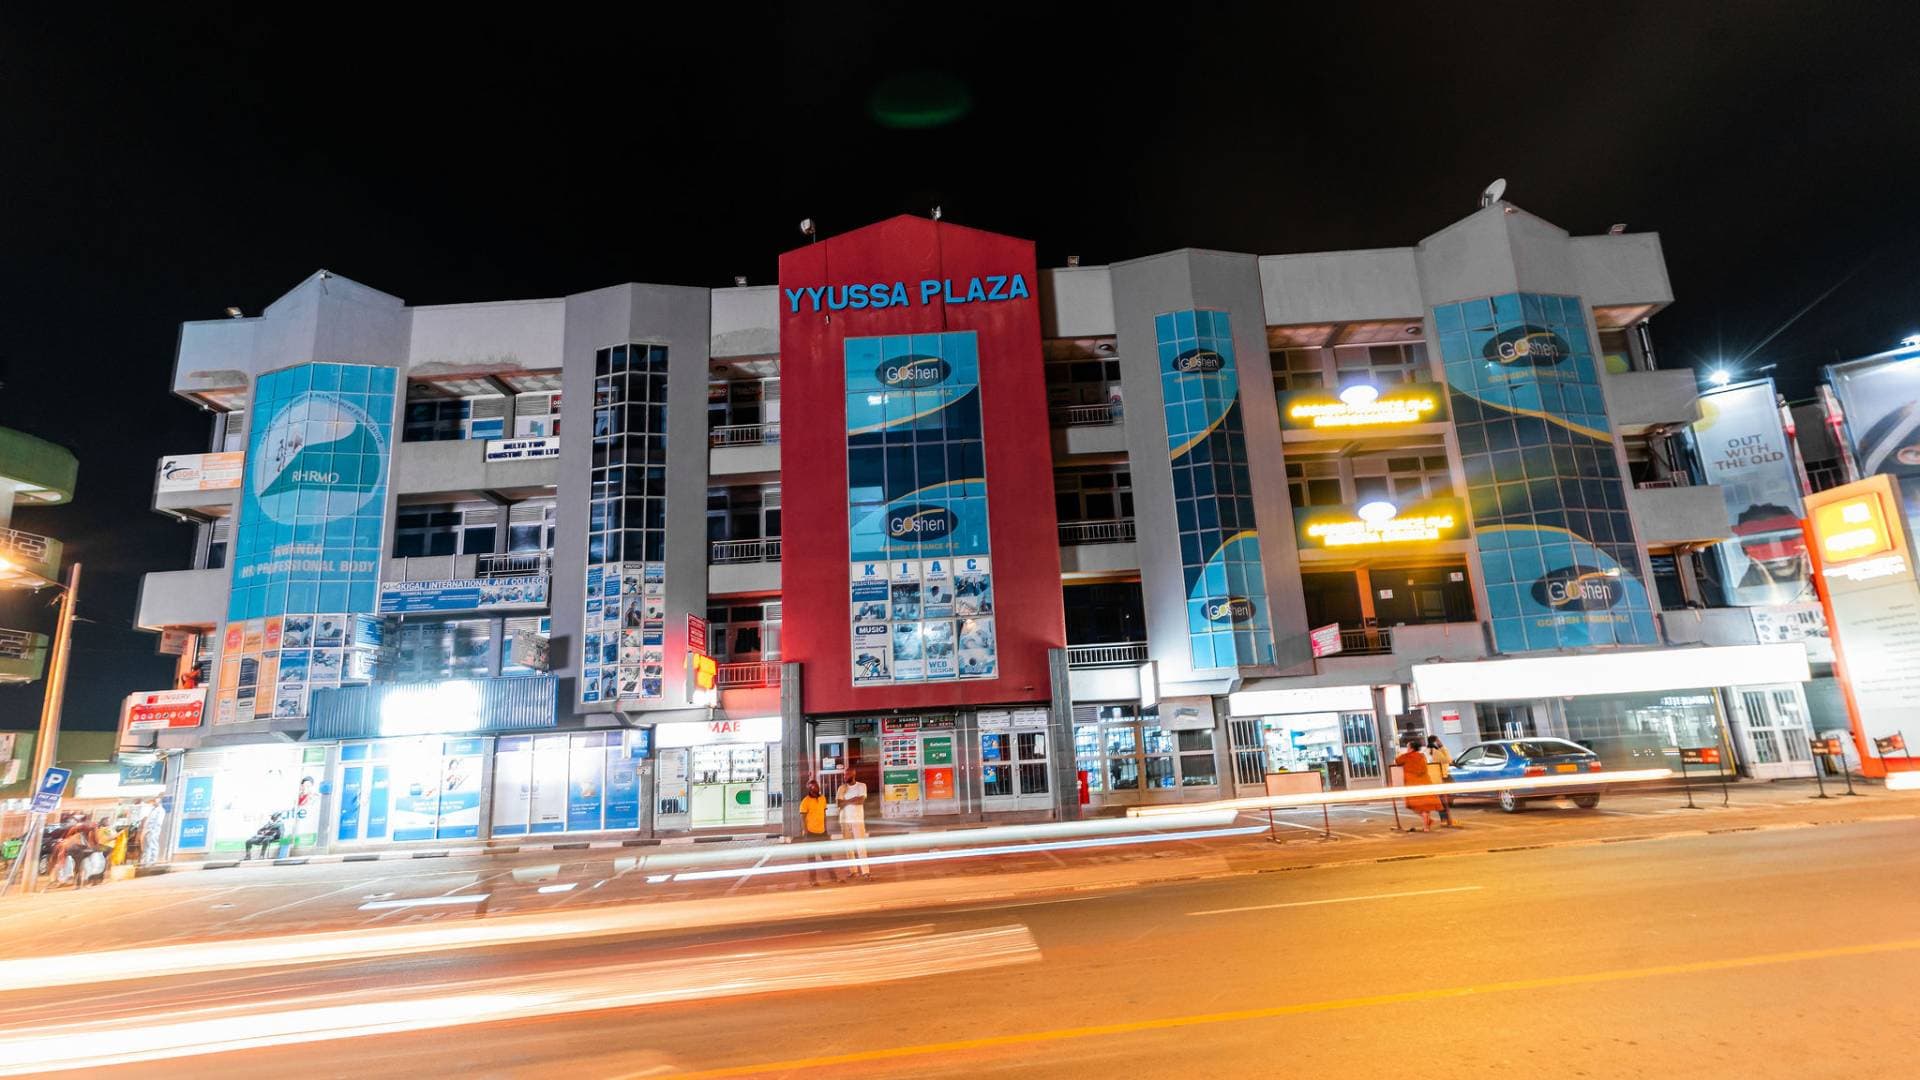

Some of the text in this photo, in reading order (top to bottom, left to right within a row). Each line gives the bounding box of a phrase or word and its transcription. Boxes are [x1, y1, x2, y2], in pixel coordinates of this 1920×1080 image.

[785, 273, 1030, 313] YYUSSA PLAZA
[1727, 433, 1762, 449] OUT
[1725, 443, 1769, 459] WITH
[1713, 451, 1785, 471] THE OLD
[257, 559, 335, 576] PROFESSIONAL
[340, 560, 376, 573] BODY
[864, 558, 977, 576] K I A C
[400, 582, 429, 592] KIGALI
[429, 579, 488, 590] INTERNATIONAL
[511, 576, 547, 586] COLLEGE
[858, 625, 885, 634] MUSIC
[929, 660, 948, 668] WEB
[45, 773, 63, 788] P
